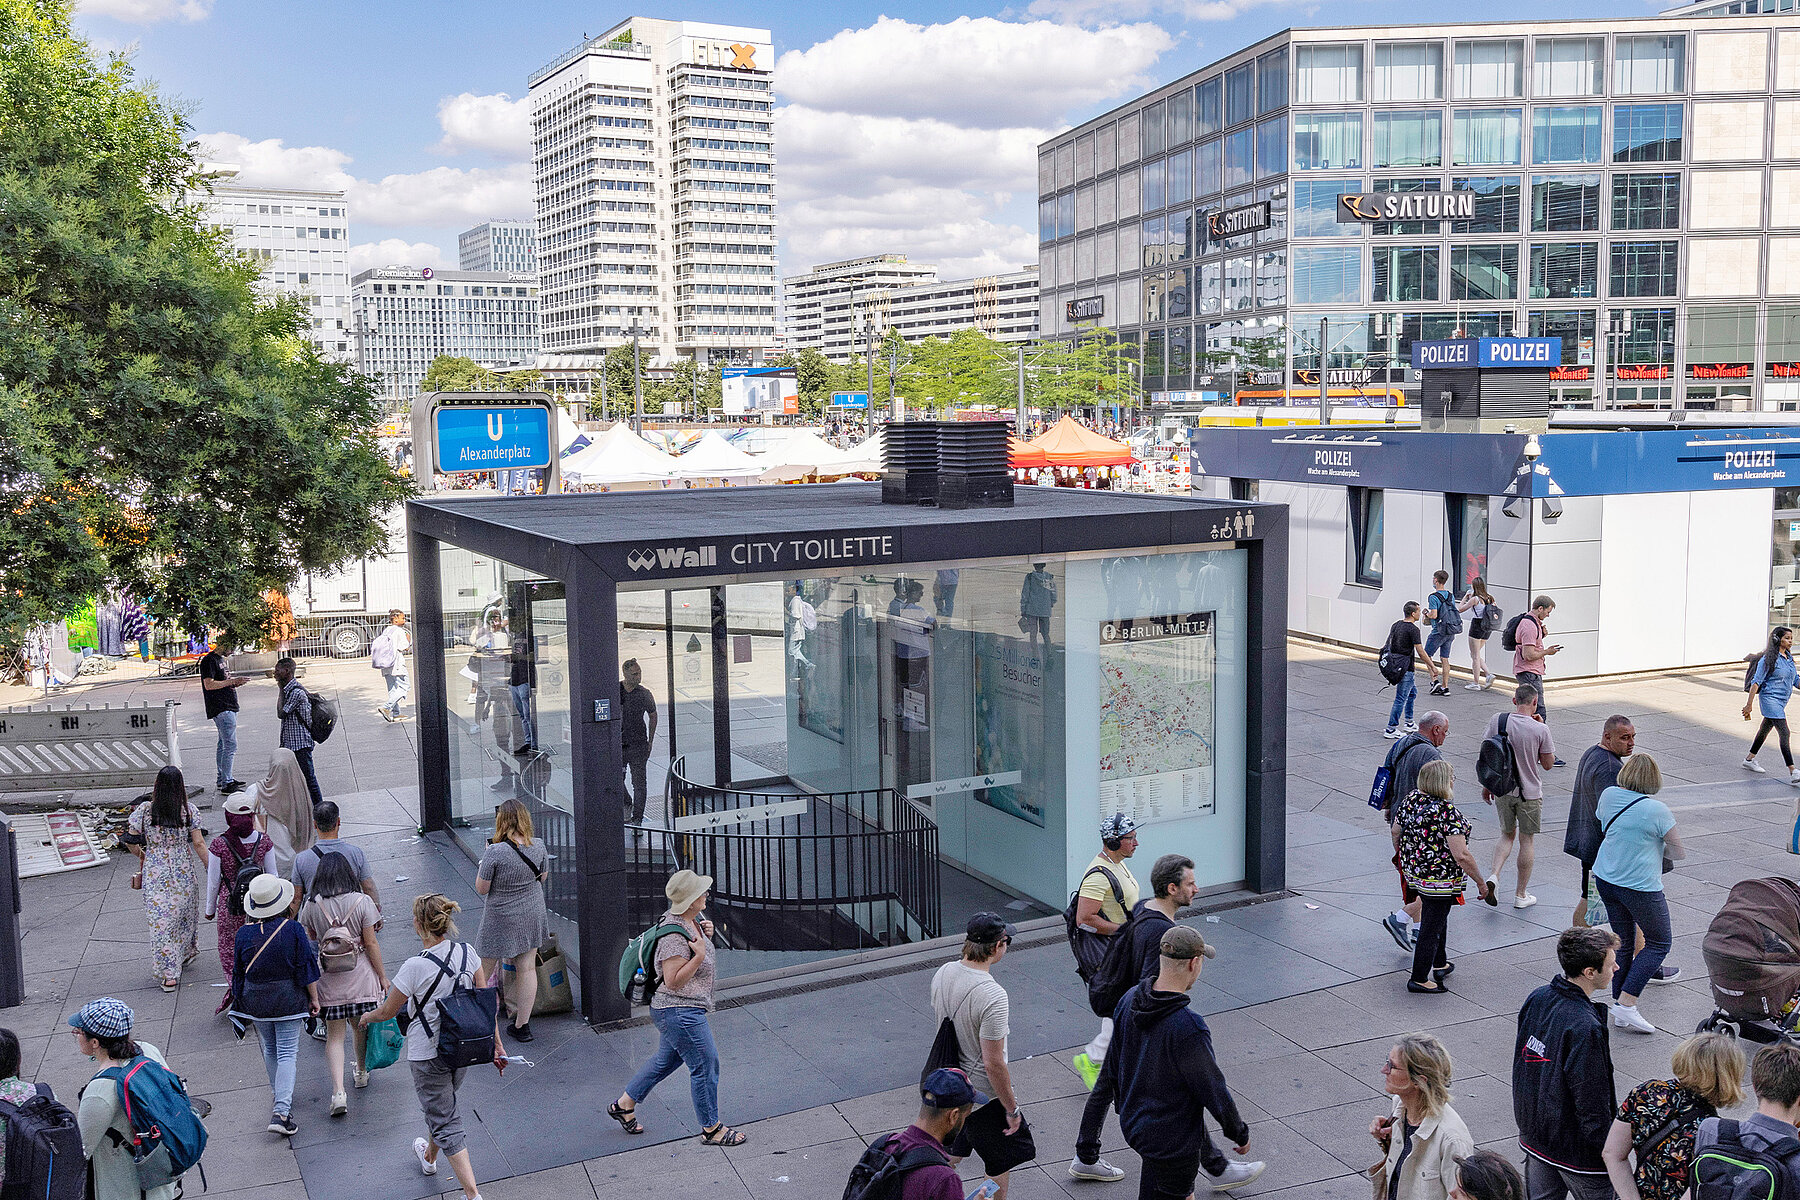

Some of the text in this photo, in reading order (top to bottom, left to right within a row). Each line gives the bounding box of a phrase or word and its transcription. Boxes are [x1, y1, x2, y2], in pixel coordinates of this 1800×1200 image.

[1385, 195, 1473, 218] SATURN
[1225, 204, 1265, 234] SATURN
[1421, 344, 1469, 364] POLIZEI
[1491, 343, 1550, 362] POLIZEI
[847, 395, 855, 403] U
[487, 414, 503, 441] U
[460, 445, 531, 462] Alexanderplatz
[1315, 450, 1352, 466] POLIZEI
[1725, 450, 1776, 469] POLIZEI
[1307, 467, 1321, 475] Wache
[1329, 468, 1360, 478] Alexanderplatz
[1713, 469, 1786, 480] Wache am Alexanderplatz
[656, 535, 893, 569] Wall CITY TOILETTE
[1122, 621, 1206, 639] BERLIN-MITTE
[1002, 663, 1041, 688] Besucher
[61, 716, 79, 730] RH
[131, 714, 149, 728] RH
